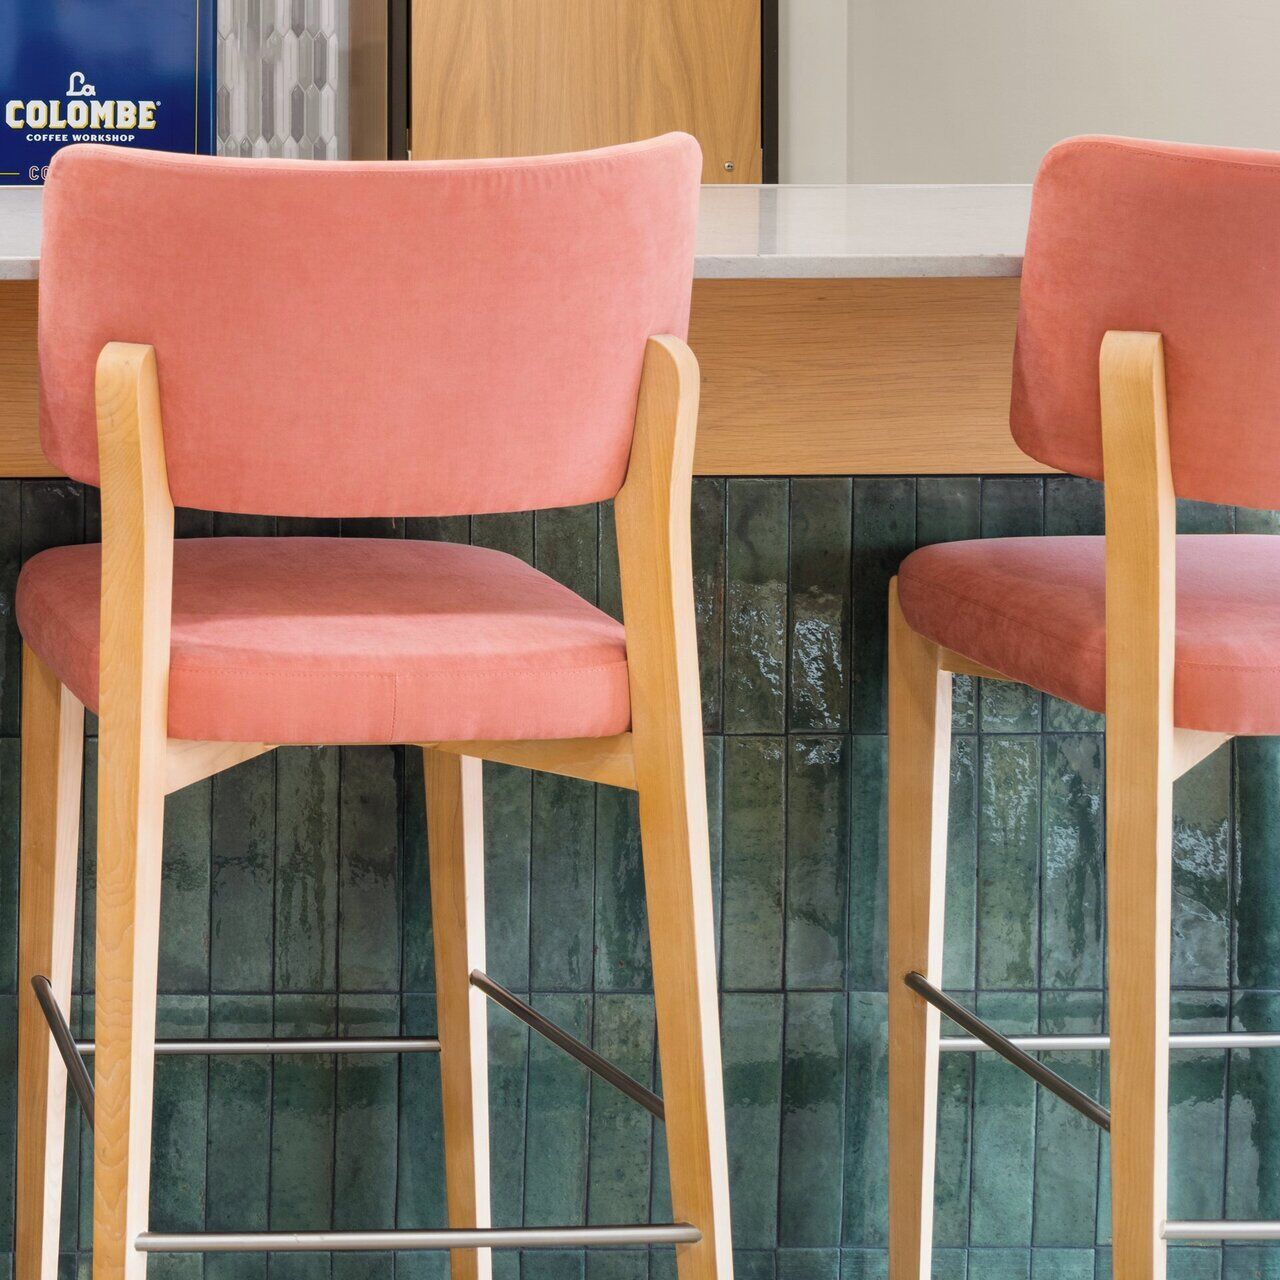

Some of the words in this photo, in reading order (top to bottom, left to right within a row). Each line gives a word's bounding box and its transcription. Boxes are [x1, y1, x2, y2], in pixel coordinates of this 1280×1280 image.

[65, 71, 96, 97] La
[5, 99, 157, 130] COLOMBE
[26, 133, 68, 142] COFFEE
[72, 133, 136, 142] WORKSHOP
